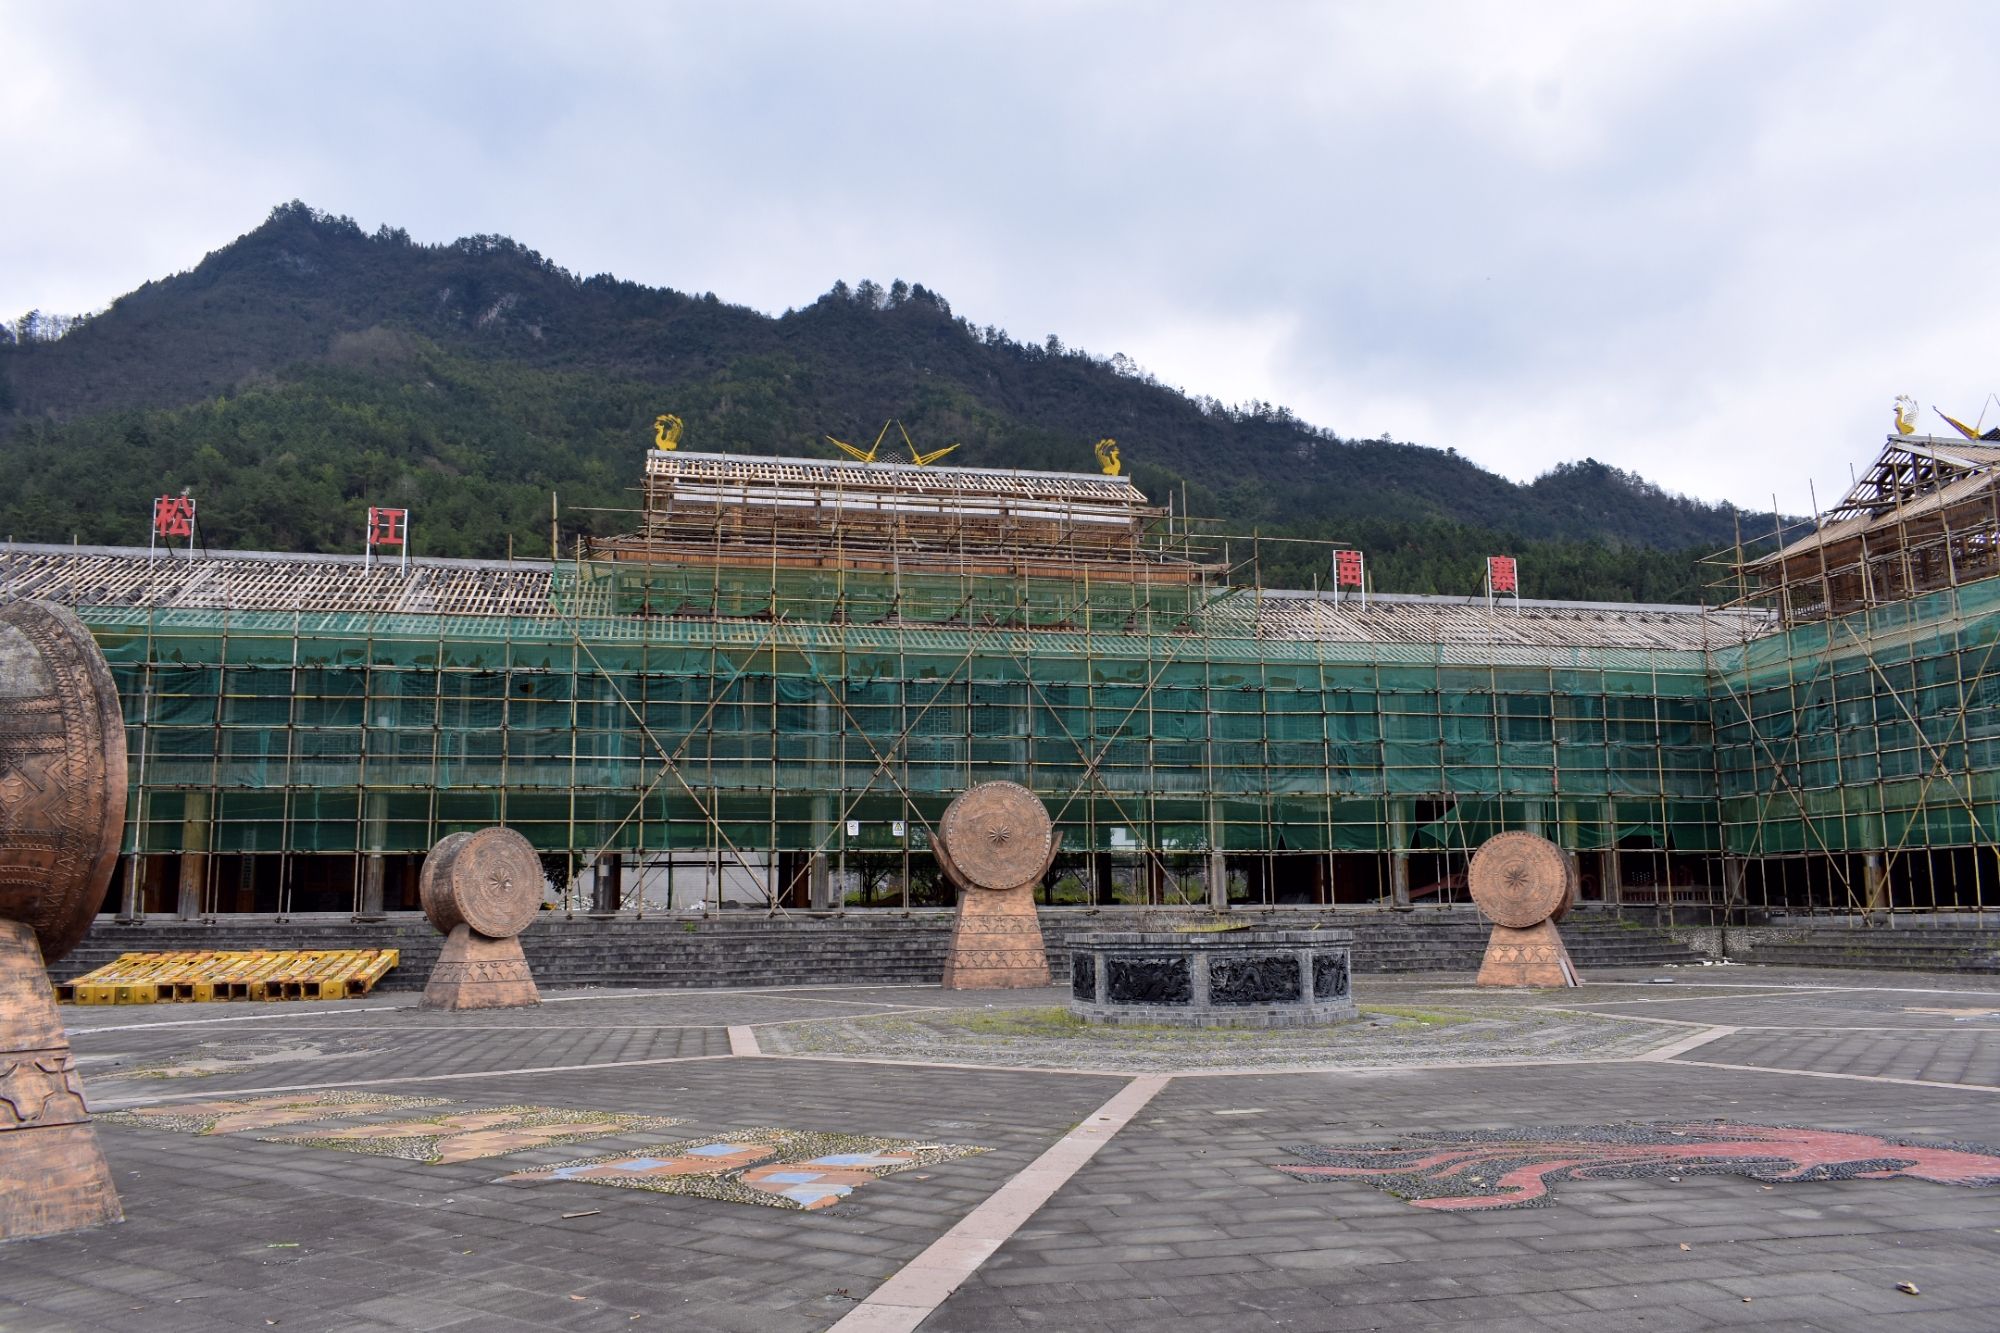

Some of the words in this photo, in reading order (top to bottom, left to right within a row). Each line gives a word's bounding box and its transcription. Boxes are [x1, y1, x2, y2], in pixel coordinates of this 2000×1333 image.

[155, 494, 193, 537] 松
[370, 506, 404, 545] 江
[1336, 551, 1362, 586] 苗
[1490, 555, 1516, 591] 寨
